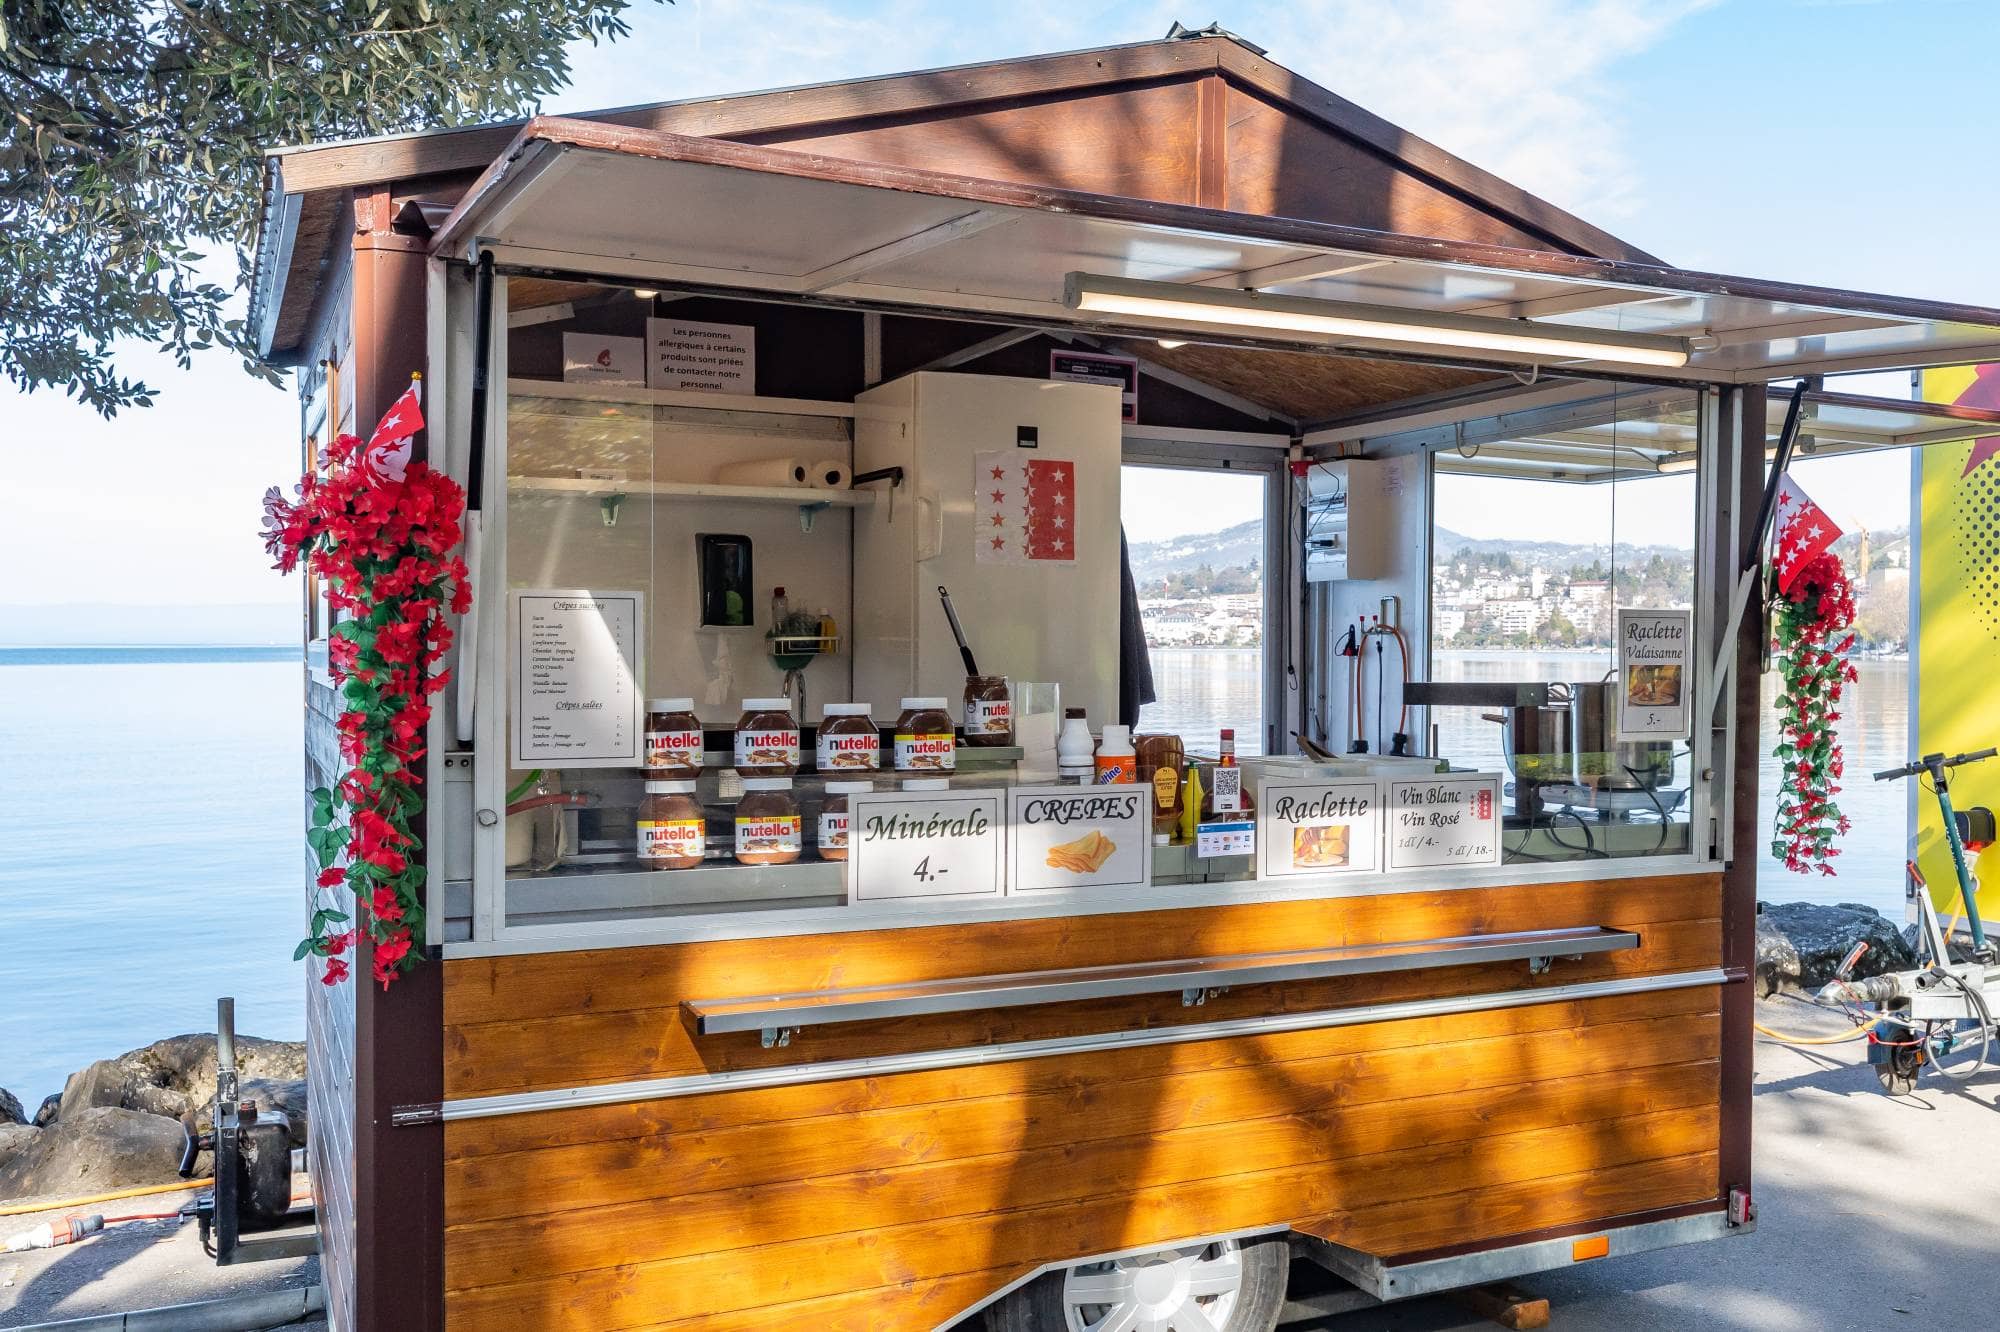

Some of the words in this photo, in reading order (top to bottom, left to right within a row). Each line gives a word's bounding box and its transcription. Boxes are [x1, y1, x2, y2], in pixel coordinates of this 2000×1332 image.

[673, 328, 687, 336] Les
[689, 330, 731, 340] personnes
[659, 340, 704, 351] allergiques
[714, 344, 746, 354] certains
[661, 353, 696, 363] produits
[699, 355, 716, 364] sont
[719, 356, 744, 367] priées
[677, 367, 716, 377] contacter
[718, 370, 740, 379] notre
[681, 380, 724, 390] personnel.
[1627, 621, 1682, 641] Raclette
[1625, 645, 1682, 659] Valaisanne
[555, 701, 580, 711] Crêpes
[983, 702, 1010, 716] nutell
[1647, 713, 1661, 725] 5.-
[645, 733, 700, 749] nutella
[745, 732, 798, 747] nutella
[829, 736, 879, 750] nutella
[906, 741, 950, 753] nutella
[1400, 788, 1423, 805] Vin
[1426, 785, 1462, 804] Blanc
[1024, 797, 1137, 825] CREPES
[1275, 791, 1368, 824] Raclette
[865, 807, 988, 842] Minérale
[1400, 812, 1425, 827] Vin
[1430, 811, 1460, 827] Rosé
[646, 827, 696, 841] nutella
[742, 824, 790, 837] nutella
[1425, 837, 1440, 847] 4.-
[1475, 845, 1493, 855] 18.-
[913, 855, 948, 883] 4.-
